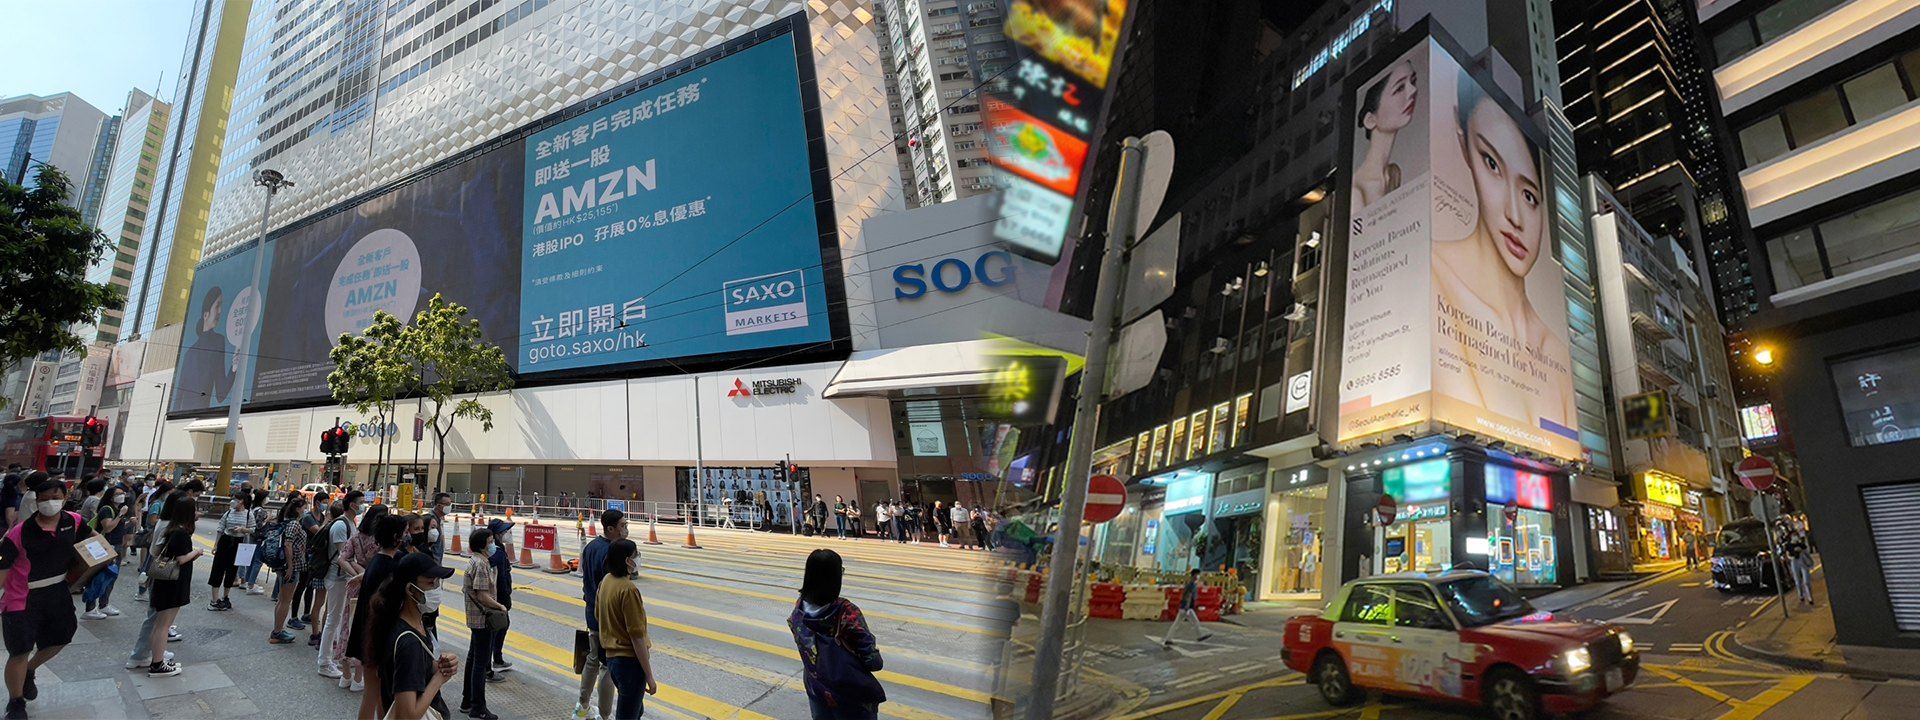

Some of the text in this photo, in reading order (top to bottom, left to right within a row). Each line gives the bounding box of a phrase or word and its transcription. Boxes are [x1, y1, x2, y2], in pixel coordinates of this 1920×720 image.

[534, 145, 611, 188] 即送一股
[533, 159, 657, 225] AMZN
[532, 233, 584, 258] 港股IPO
[1353, 220, 1421, 260] Korean Beauty
[1351, 254, 1408, 290] Reimagined
[1352, 250, 1395, 272] Solutions
[344, 279, 398, 308] AMZN
[731, 280, 795, 306] SAXO
[1366, 284, 1383, 298] You
[530, 296, 647, 343] 立即開戶
[735, 311, 797, 327] MARKETS
[529, 330, 647, 364] goto.saxo/hk
[1437, 294, 1567, 374] Korean Beauty Solutions
[1437, 316, 1547, 382] Reimagined for You
[752, 378, 802, 388] MITSUBISHI
[753, 386, 796, 396] ELECTRIC
[525, 527, 555, 535] PEDESTRIANS
